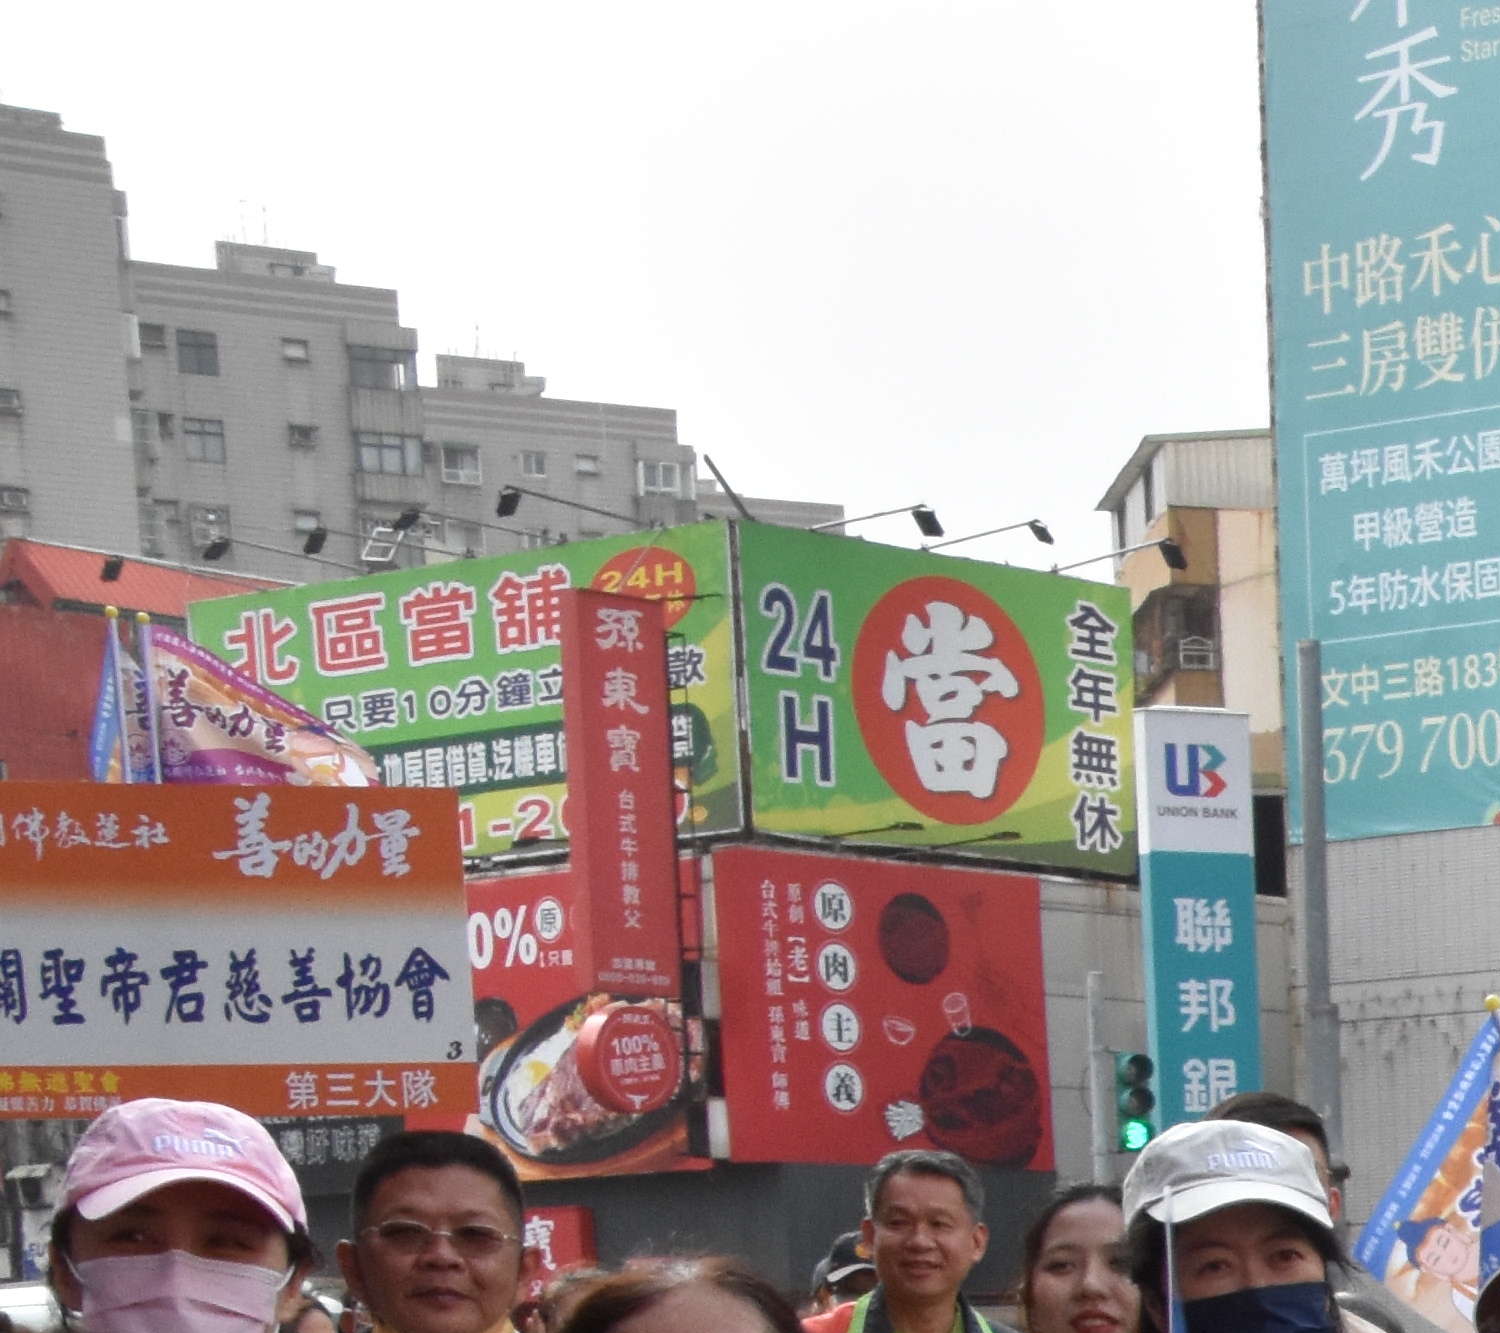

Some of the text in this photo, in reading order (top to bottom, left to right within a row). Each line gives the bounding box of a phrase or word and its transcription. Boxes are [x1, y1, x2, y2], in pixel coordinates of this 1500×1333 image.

[1351, 497, 1479, 552] 甲級營造
[599, 561, 683, 592] 24H
[222, 564, 572, 686] 北區當舖
[758, 583, 840, 683] 24
[595, 606, 650, 774] 孫東寶
[881, 600, 1021, 799] 當
[1065, 603, 1124, 854] 全年無休
[779, 692, 836, 787] H
[1322, 720, 1404, 786] 379
[0, 806, 172, 862] 佛教蓮社
[212, 791, 421, 880] 善的力量
[1157, 804, 1240, 821] UNION BANK
[618, 788, 642, 929] 台式牛排教父
[818, 885, 858, 1109] 原肉主義
[1173, 896, 1241, 1120] 聯邦銀
[446, 1040, 464, 1061] 3
[611, 1034, 661, 1056] 100%
[284, 1069, 440, 1109] 第三大隊
[152, 1133, 234, 1159] PUMA
[1207, 1151, 1272, 1171] PUMA
